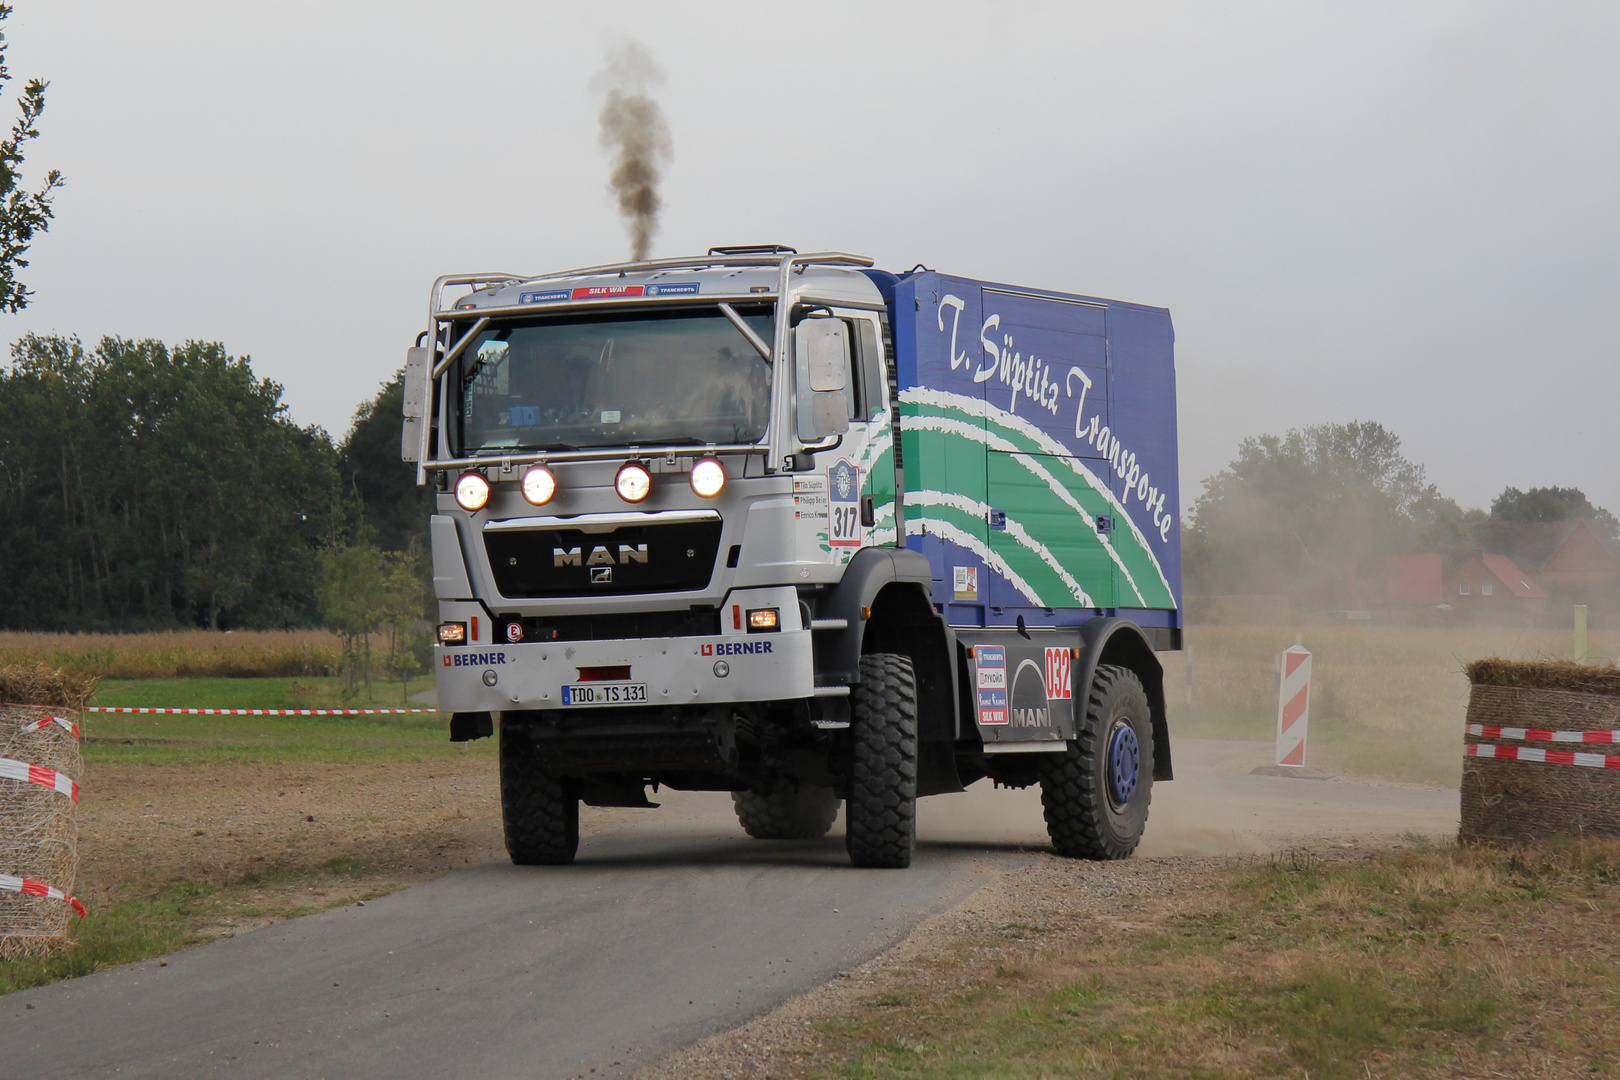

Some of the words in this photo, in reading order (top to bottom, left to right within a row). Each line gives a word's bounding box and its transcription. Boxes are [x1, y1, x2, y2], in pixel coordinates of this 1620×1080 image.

[589, 287, 607, 295] SILK
[974, 314, 1059, 416] Süptitz
[1066, 366, 1172, 543] Transporte
[800, 496, 815, 506] Philipp
[801, 511, 814, 519] Enrico
[834, 506, 857, 538] 317
[553, 543, 649, 568] MAN
[716, 641, 773, 656] BERNER
[454, 652, 507, 667] BERNER
[1045, 648, 1071, 699] 032
[570, 687, 594, 702] TDO
[603, 686, 619, 702] TS
[622, 685, 646, 701] 131
[982, 711, 993, 722] SILK
[993, 711, 1004, 722] WAY
[1013, 708, 1047, 728] MAN
